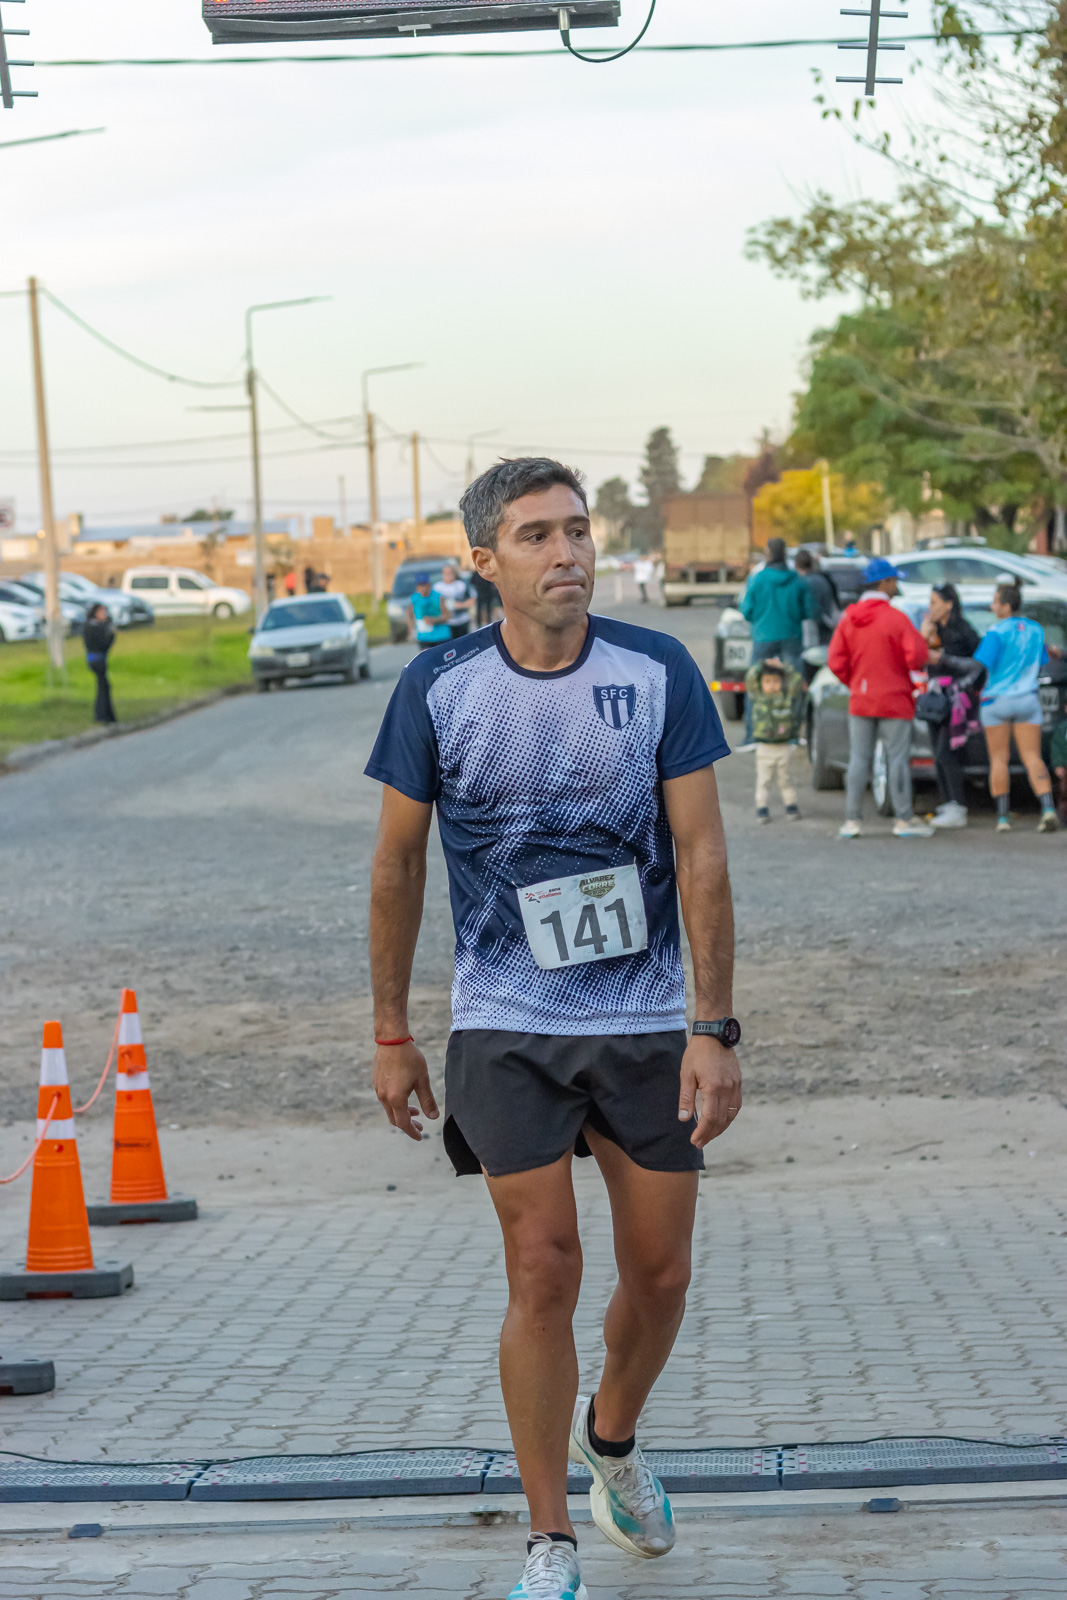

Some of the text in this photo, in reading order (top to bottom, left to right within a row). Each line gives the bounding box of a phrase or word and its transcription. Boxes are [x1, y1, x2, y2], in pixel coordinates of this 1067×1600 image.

[601, 689, 628, 699] SFC
[579, 874, 616, 887] ALVAREZ
[581, 880, 616, 892] CORRE
[540, 898, 632, 961] 141
